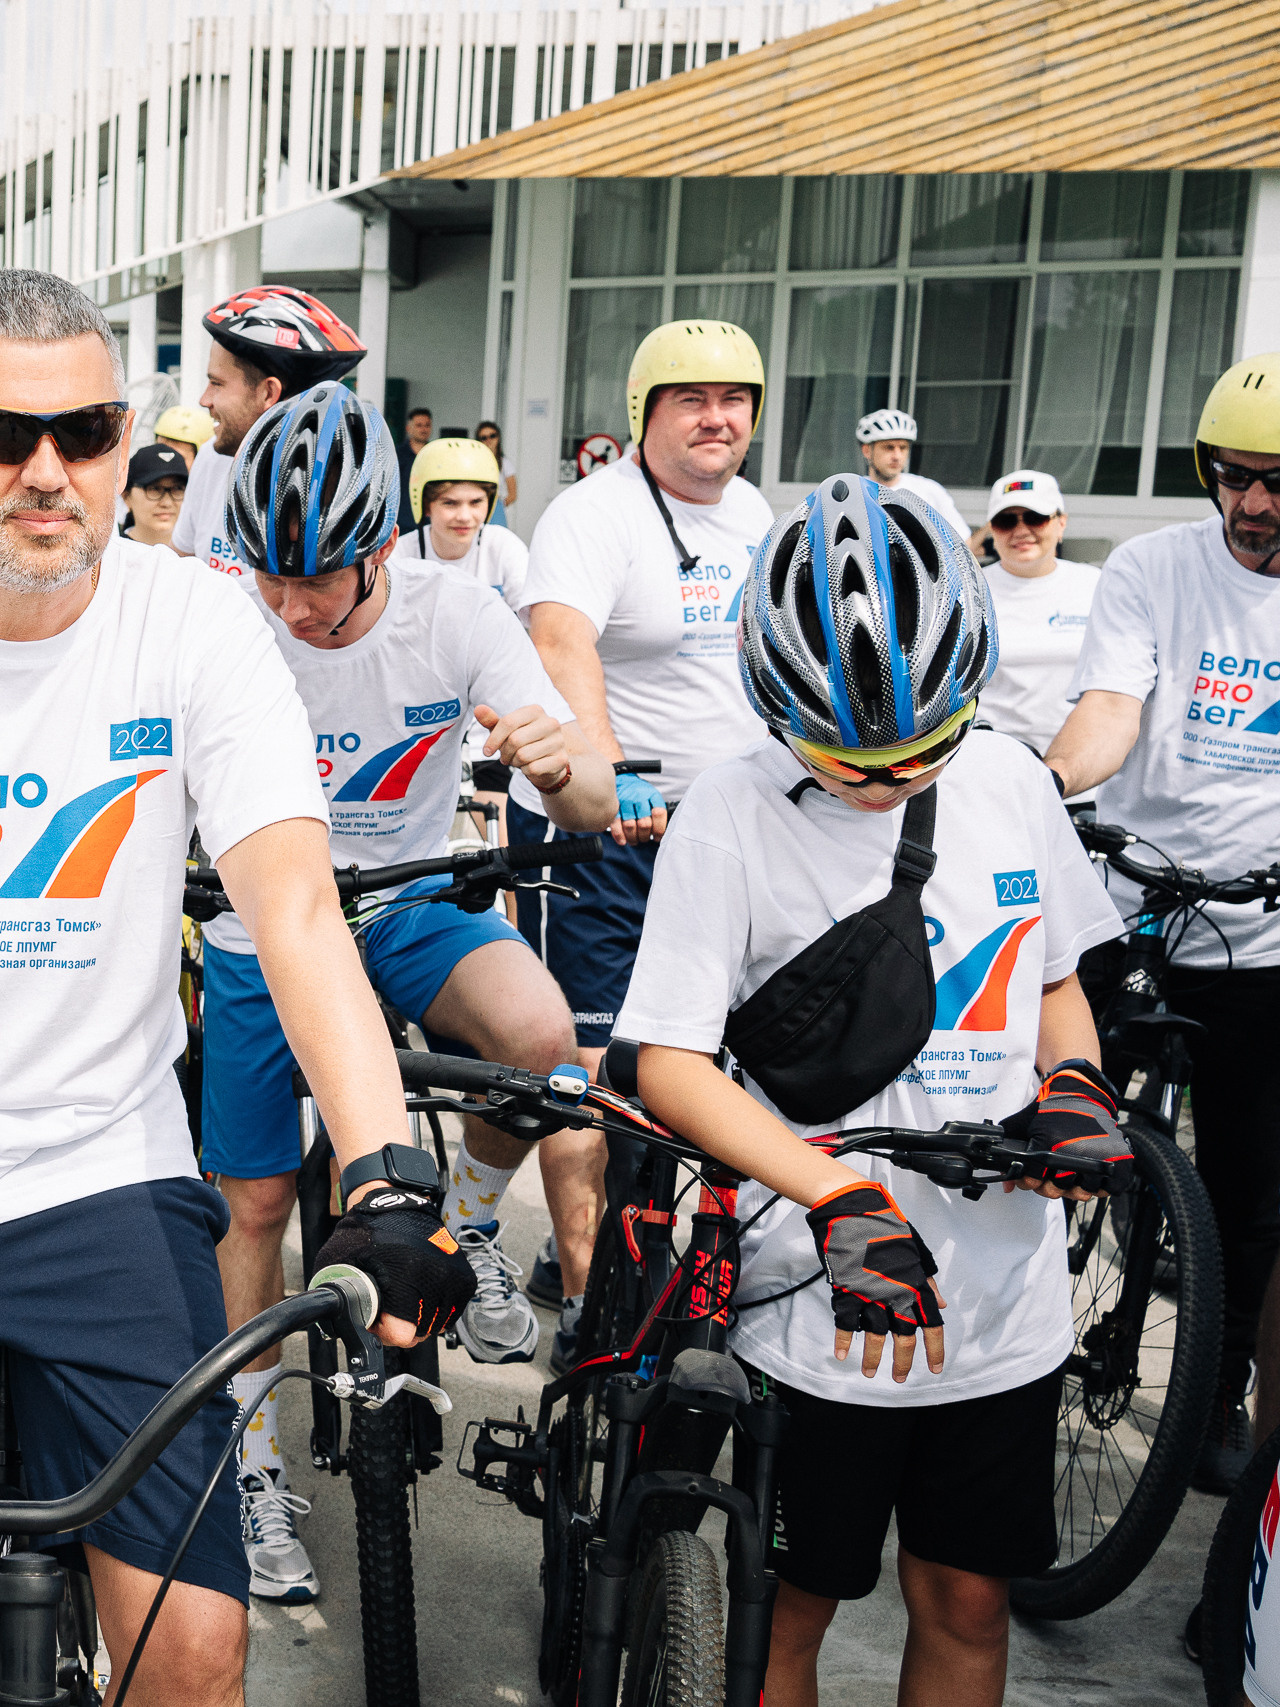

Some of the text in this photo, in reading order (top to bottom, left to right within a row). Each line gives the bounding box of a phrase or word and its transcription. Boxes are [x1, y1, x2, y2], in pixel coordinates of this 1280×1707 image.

[681, 585, 720, 601] PRO
[1193, 675, 1254, 703] PRO
[408, 702, 458, 724] 2022
[55, 918, 102, 932] Томск»
[15, 941, 58, 953] ЛПУМГ
[29, 957, 96, 970] организация
[968, 1049, 1007, 1062] Томск»
[938, 1069, 971, 1080] ЛПУМГ
